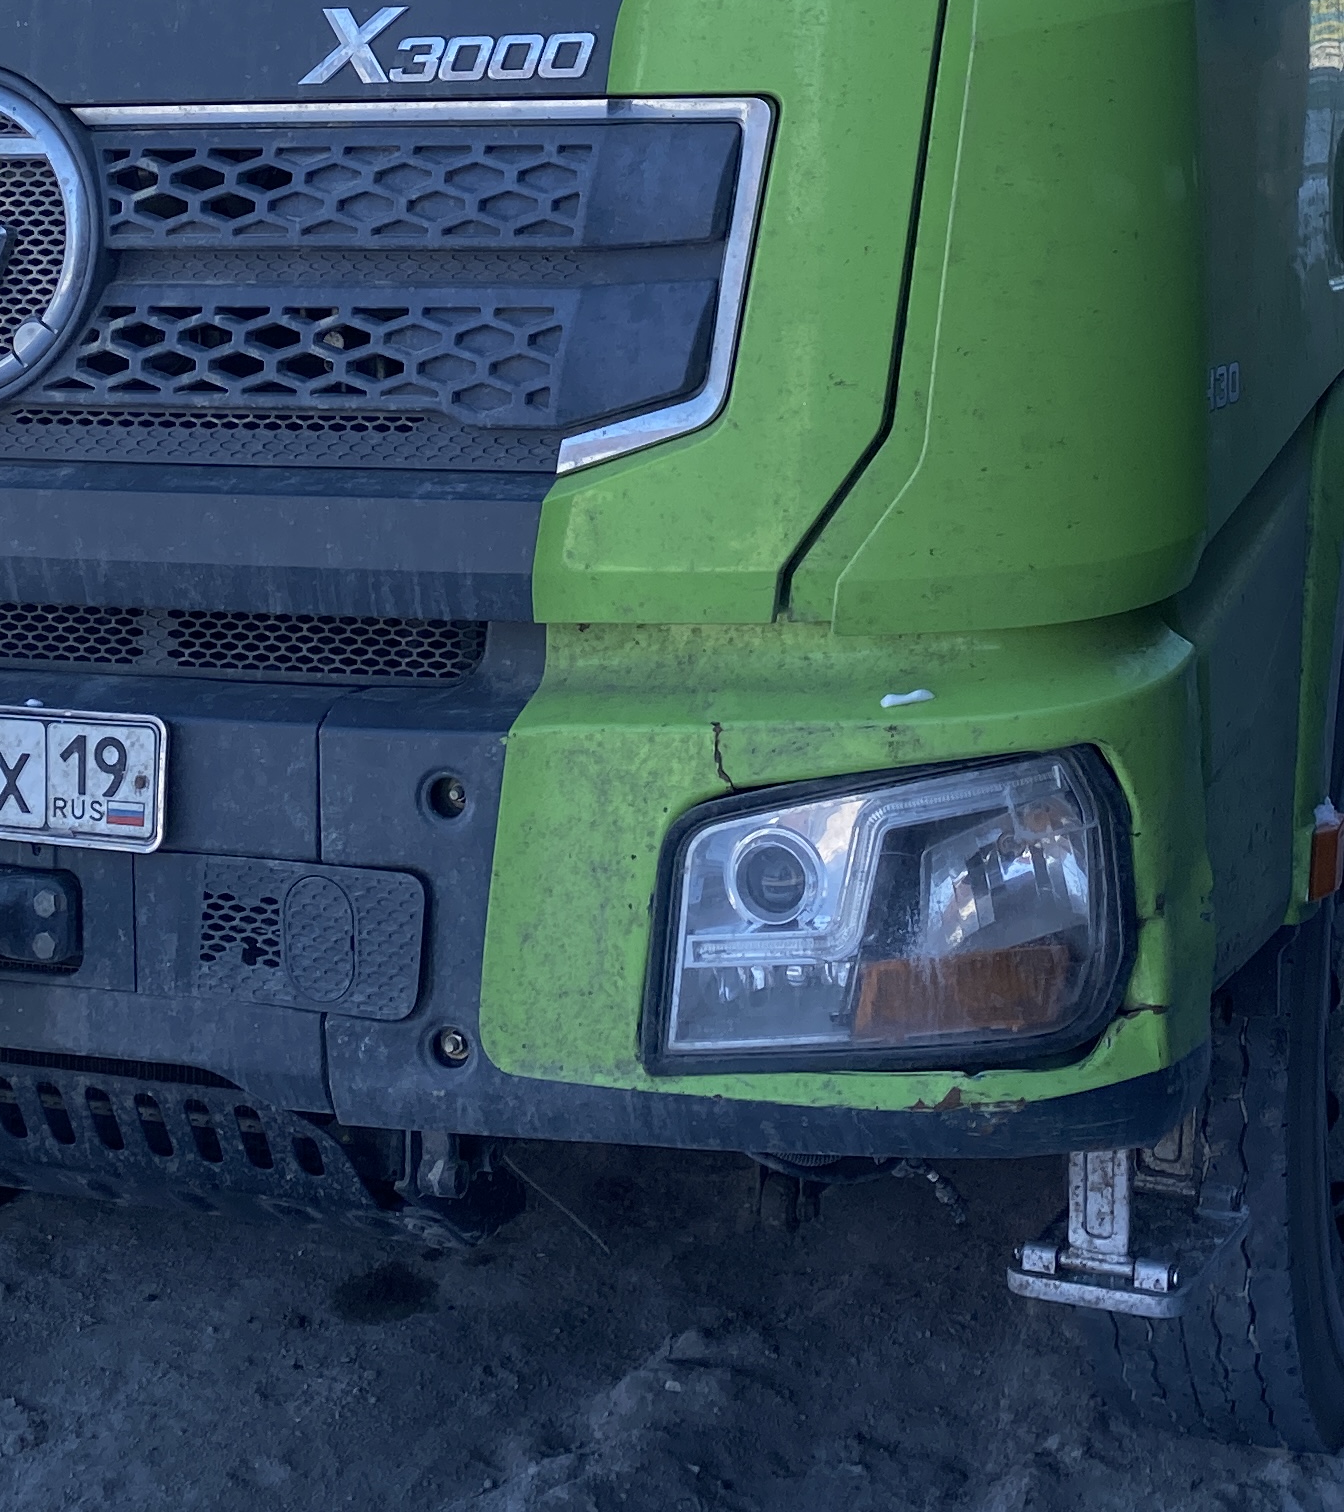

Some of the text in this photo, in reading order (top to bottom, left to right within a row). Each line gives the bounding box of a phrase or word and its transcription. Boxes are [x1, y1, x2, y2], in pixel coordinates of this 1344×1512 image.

[297, 5, 595, 86] X3000
[59, 733, 128, 798] 19
[52, 796, 105, 822] RUS
